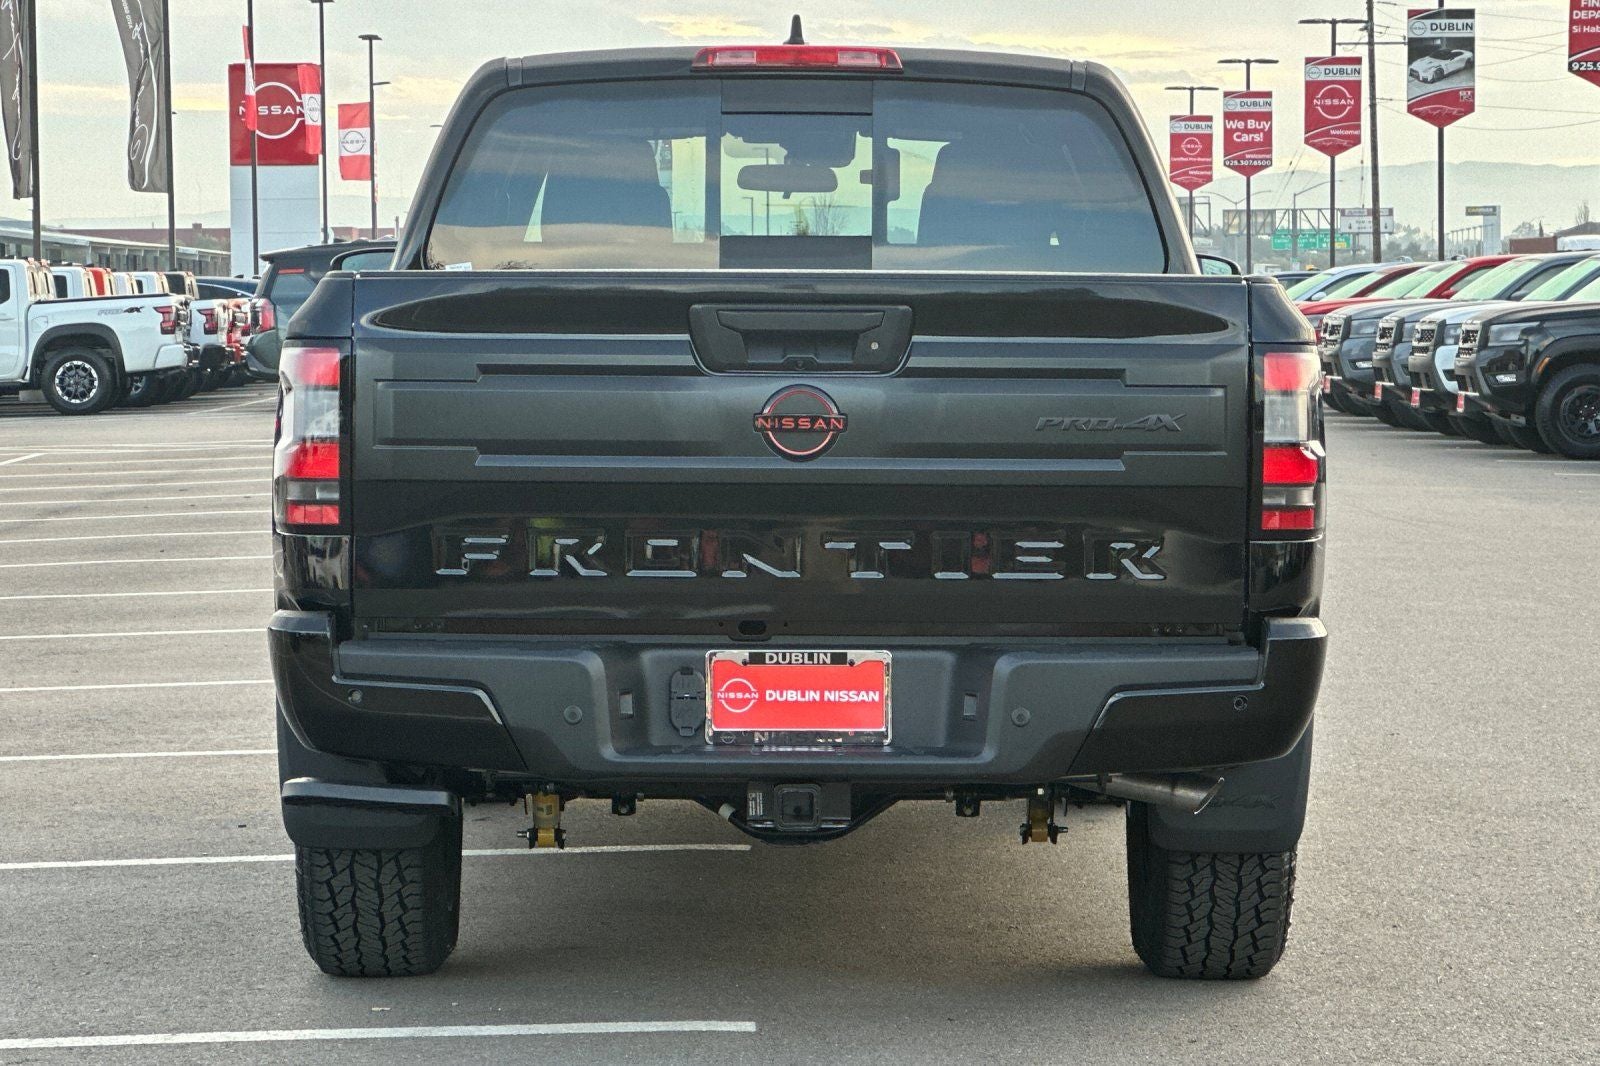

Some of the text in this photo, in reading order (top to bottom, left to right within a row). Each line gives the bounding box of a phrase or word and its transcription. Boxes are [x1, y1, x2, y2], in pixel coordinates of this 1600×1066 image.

[1430, 22, 1473, 31] DUBLIN
[1572, 25, 1581, 33] Si
[1324, 67, 1361, 76] DUBLIN
[1240, 100, 1272, 108] DUBLIN
[1313, 98, 1355, 106] NISSAN
[239, 105, 305, 116] NSSAN
[1225, 119, 1271, 132] We Buy
[1233, 132, 1264, 142] Cars!
[757, 416, 844, 430] NISSAN
[1035, 413, 1187, 432] PRO-4X
[432, 527, 1167, 582] FRONTIER
[765, 652, 831, 665] DUBLIN
[717, 691, 759, 699] NISSAN
[765, 689, 880, 702] DUBLIN NISSAN
